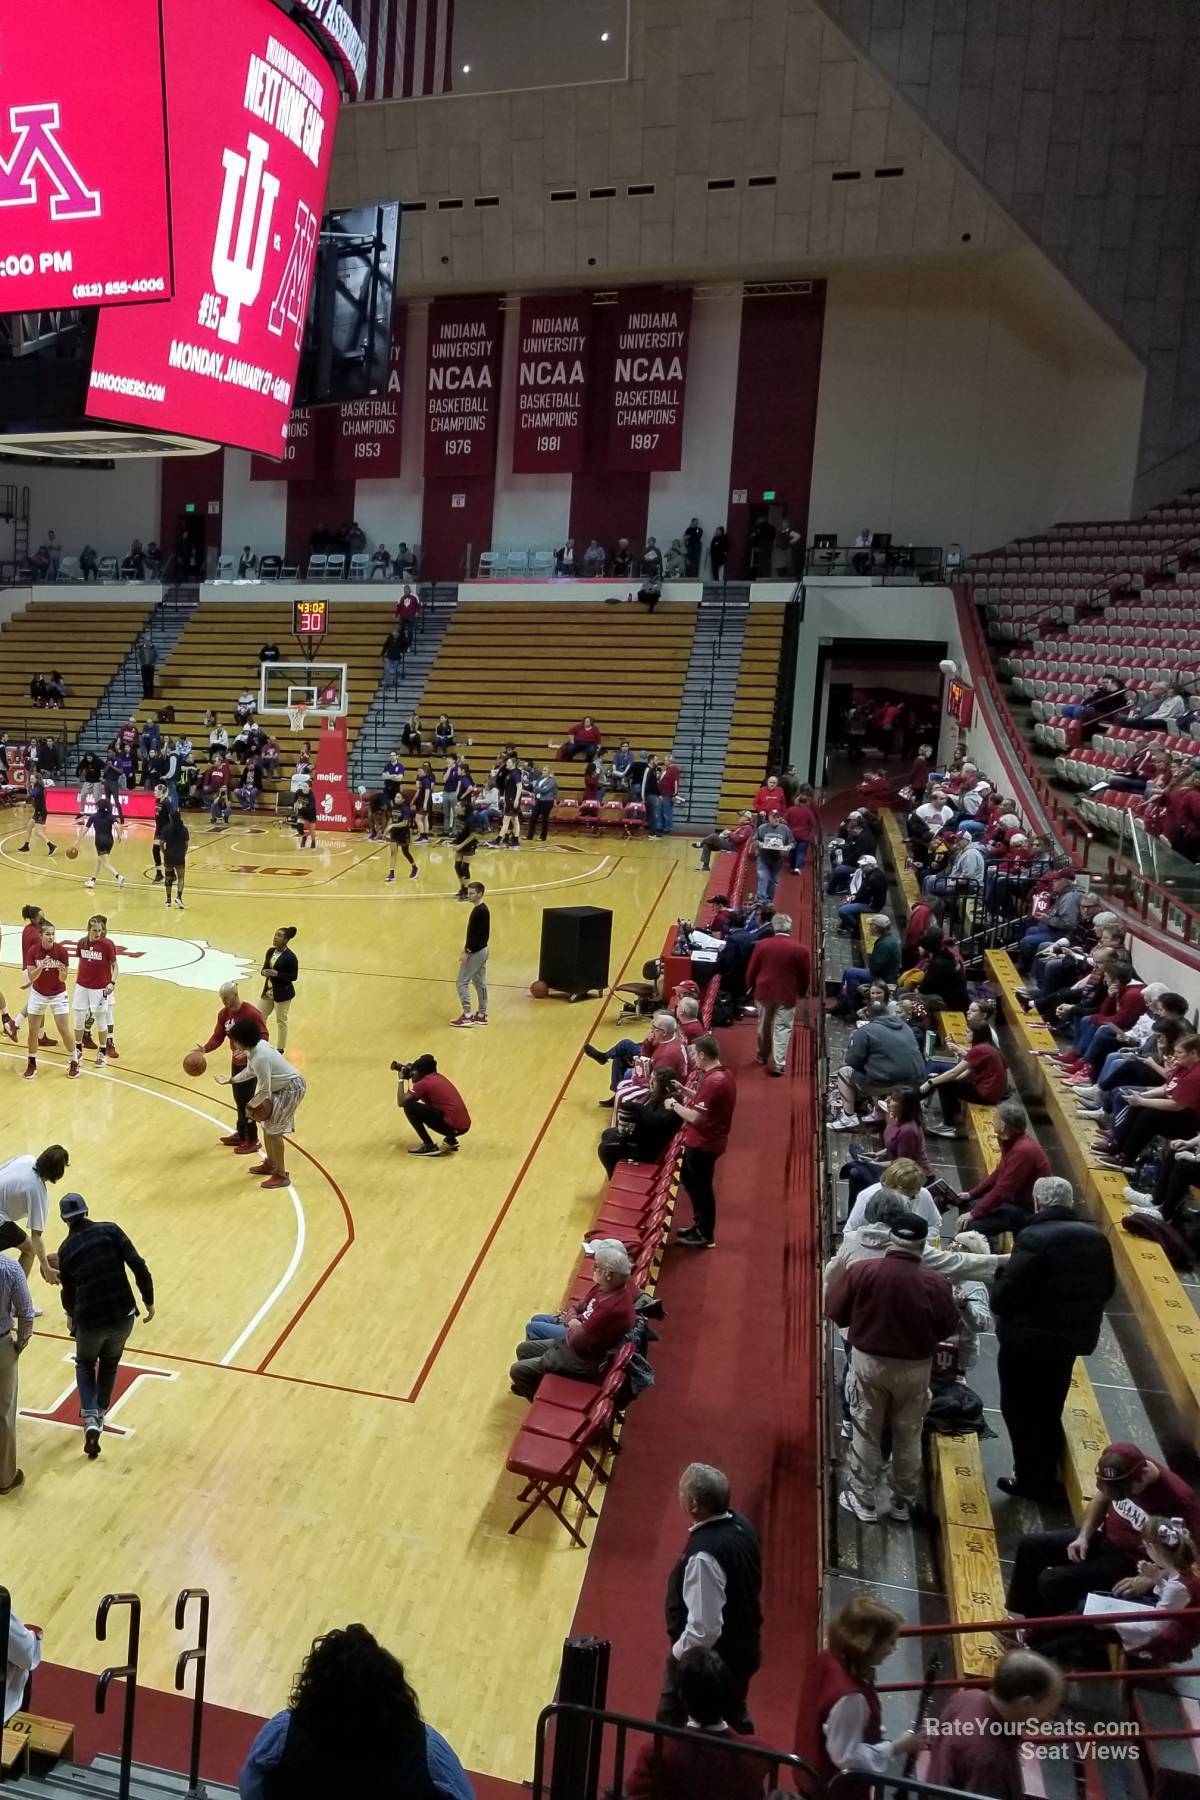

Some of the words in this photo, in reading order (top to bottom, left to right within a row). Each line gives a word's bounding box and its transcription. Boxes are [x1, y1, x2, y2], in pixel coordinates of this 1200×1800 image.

[244, 53, 282, 126] NEXT
[275, 76, 309, 149] HOME
[39, 250, 72, 273] PM
[73, 283, 102, 299] (812)
[105, 278, 164, 295] 855-4006
[198, 292, 221, 330] #15
[531, 317, 579, 334] INDIANA
[628, 312, 678, 329] INDIANA
[440, 323, 486, 339] INDIANA
[523, 336, 586, 353] UNIVERSITY
[619, 331, 684, 349] UNIVERSITY
[432, 341, 493, 358] UNIVERSITY
[169, 340, 224, 383] MONDAY,
[224, 356, 265, 395] JANUARY
[520, 361, 584, 385] NCAA
[615, 357, 683, 382] NCAA
[90, 371, 165, 402] IUHOOSIERS.COM
[429, 365, 492, 391] NCAA
[429, 397, 488, 414] BASKETBALL
[520, 392, 581, 409] BASKETBALL
[615, 390, 679, 407] BASKETBALL
[341, 401, 398, 417] BASKETBALL
[617, 409, 676, 426] CHAMPIONS
[343, 419, 395, 436] CHAMPIONS
[431, 416, 486, 432] CHAMPIONS
[521, 412, 578, 428] CHAMPIONS
[445, 439, 471, 455] 1976
[537, 436, 561, 451] 1981
[631, 434, 660, 449] 1987
[354, 443, 380, 458] 1953
[297, 603, 325, 613] 43:02
[301, 613, 320, 630] 30
[317, 772, 343, 783] meijer
[954, 1465, 972, 1477] 132
[960, 1501, 978, 1515] 133
[965, 1540, 985, 1554] 134
[971, 1591, 992, 1606] 135
